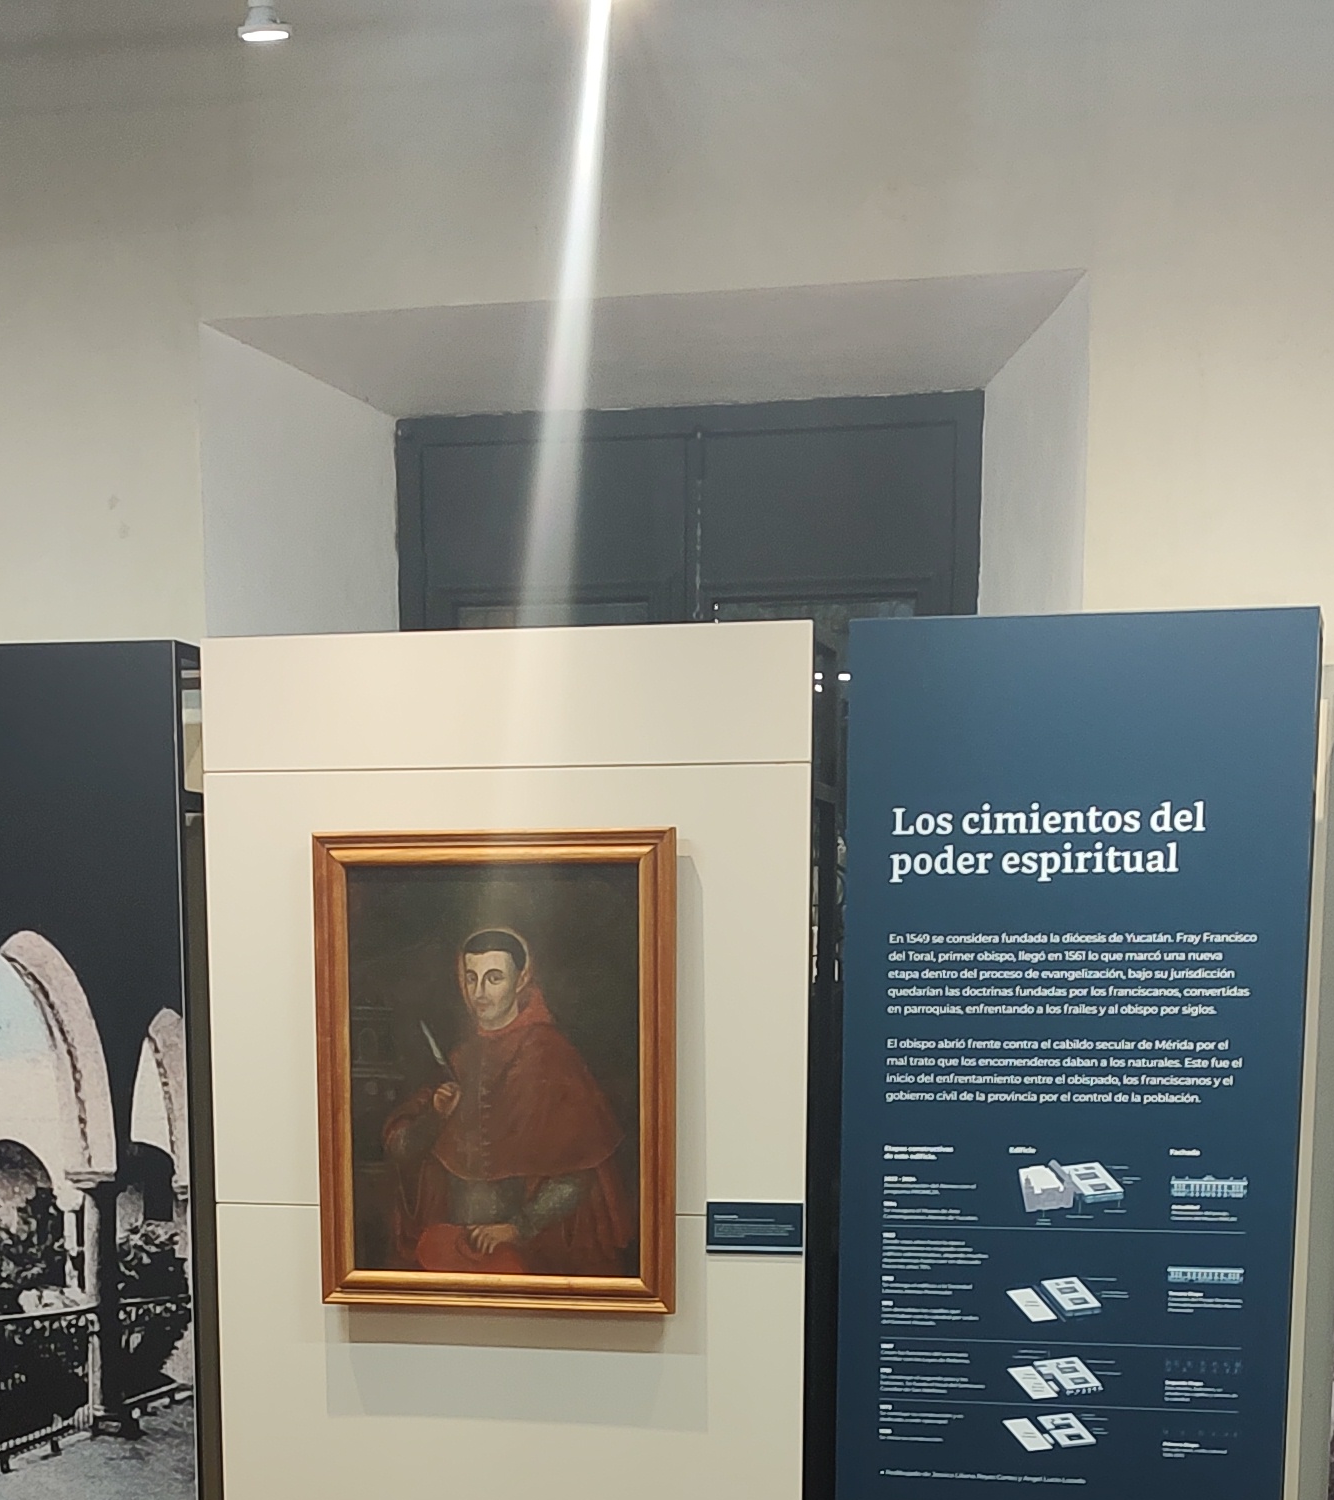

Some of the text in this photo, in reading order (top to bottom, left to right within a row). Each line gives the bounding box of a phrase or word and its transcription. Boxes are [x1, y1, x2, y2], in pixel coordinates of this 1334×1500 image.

[892, 801, 1206, 835] Los cimientos del
[889, 842, 1179, 883] poder espiritual
[889, 934, 904, 944] En
[906, 933, 930, 944] 1549
[932, 935, 944, 943] se
[946, 933, 999, 943] considera
[1001, 932, 1048, 943] fundada
[1050, 933, 1060, 943] la
[1062, 933, 1107, 943] diócesis
[1108, 932, 1124, 943] de
[1176, 932, 1201, 945] Fray
[1202, 931, 1258, 943] Francisco
[888, 951, 906, 961] del
[938, 951, 975, 963] primer
[1018, 950, 1046, 963] llegó
[1047, 953, 1063, 961] en
[1088, 950, 1099, 961] lo
[1100, 953, 1123, 963] que
[1125, 950, 1162, 961] marcó
[1163, 952, 1186, 961] una
[1188, 952, 1223, 961] nueva
[888, 970, 919, 980] etapa
[921, 969, 958, 979] dentro
[959, 968, 977, 979] del
[979, 971, 1023, 980] proceso
[1024, 968, 1040, 979] de
[1128, 968, 1153, 981] bajo
[1154, 970, 1168, 979] su
[1168, 968, 1235, 981] jurisdicción
[887, 986, 943, 998] quedarían
[945, 985, 960, 996] las
[962, 986, 1014, 996] doctrinas
[1015, 985, 1067, 996] fundadas
[1068, 988, 1089, 998] por
[1090, 986, 1107, 996] los
[1183, 986, 1251, 997] convertidas
[887, 1006, 902, 1014] en
[965, 1003, 1035, 1014] enfrentando
[1036, 1006, 1043, 1014] a
[1045, 1004, 1062, 1014] los
[1063, 1003, 1098, 1014] frailes
[1098, 1006, 1107, 1016] y
[1107, 1003, 1118, 1014] al
[1120, 1004, 1159, 1016] obispo
[1160, 1006, 1180, 1016] por
[887, 1038, 1229, 1052] El obispo abrió frente contra el cabildo secular de Mérida por el
[886, 1056, 907, 1066] mal
[909, 1057, 936, 1066] trato
[937, 1058, 959, 1068] que
[961, 1056, 977, 1066] los
[978, 1057, 1061, 1067] encomenderos
[1062, 1057, 1098, 1067] daban
[1100, 1059, 1108, 1067] a
[1109, 1057, 1126, 1067] los
[1184, 1057, 1209, 1068] Este
[1210, 1057, 1230, 1068] fue
[1231, 1057, 1243, 1068] el
[886, 1073, 915, 1083] inicio
[917, 1073, 934, 1083] del
[936, 1073, 1022, 1084] enfrentamiento
[1023, 1075, 1053, 1084] entre
[1055, 1074, 1065, 1084] el
[1123, 1074, 1139, 1085] los
[1140, 1075, 1212, 1086] franciscanos
[1212, 1077, 1221, 1088] y
[1222, 1075, 1233, 1086] el
[885, 1090, 935, 1102] gobierno
[936, 1091, 957, 1101] civil
[959, 1091, 974, 1101] de
[976, 1091, 985, 1101] la
[987, 1091, 1037, 1103] provincia
[1039, 1094, 1059, 1104] por
[1060, 1091, 1071, 1102] el
[1072, 1092, 1112, 1102] control
[1114, 1092, 1129, 1102] de
[1131, 1092, 1141, 1102] la
